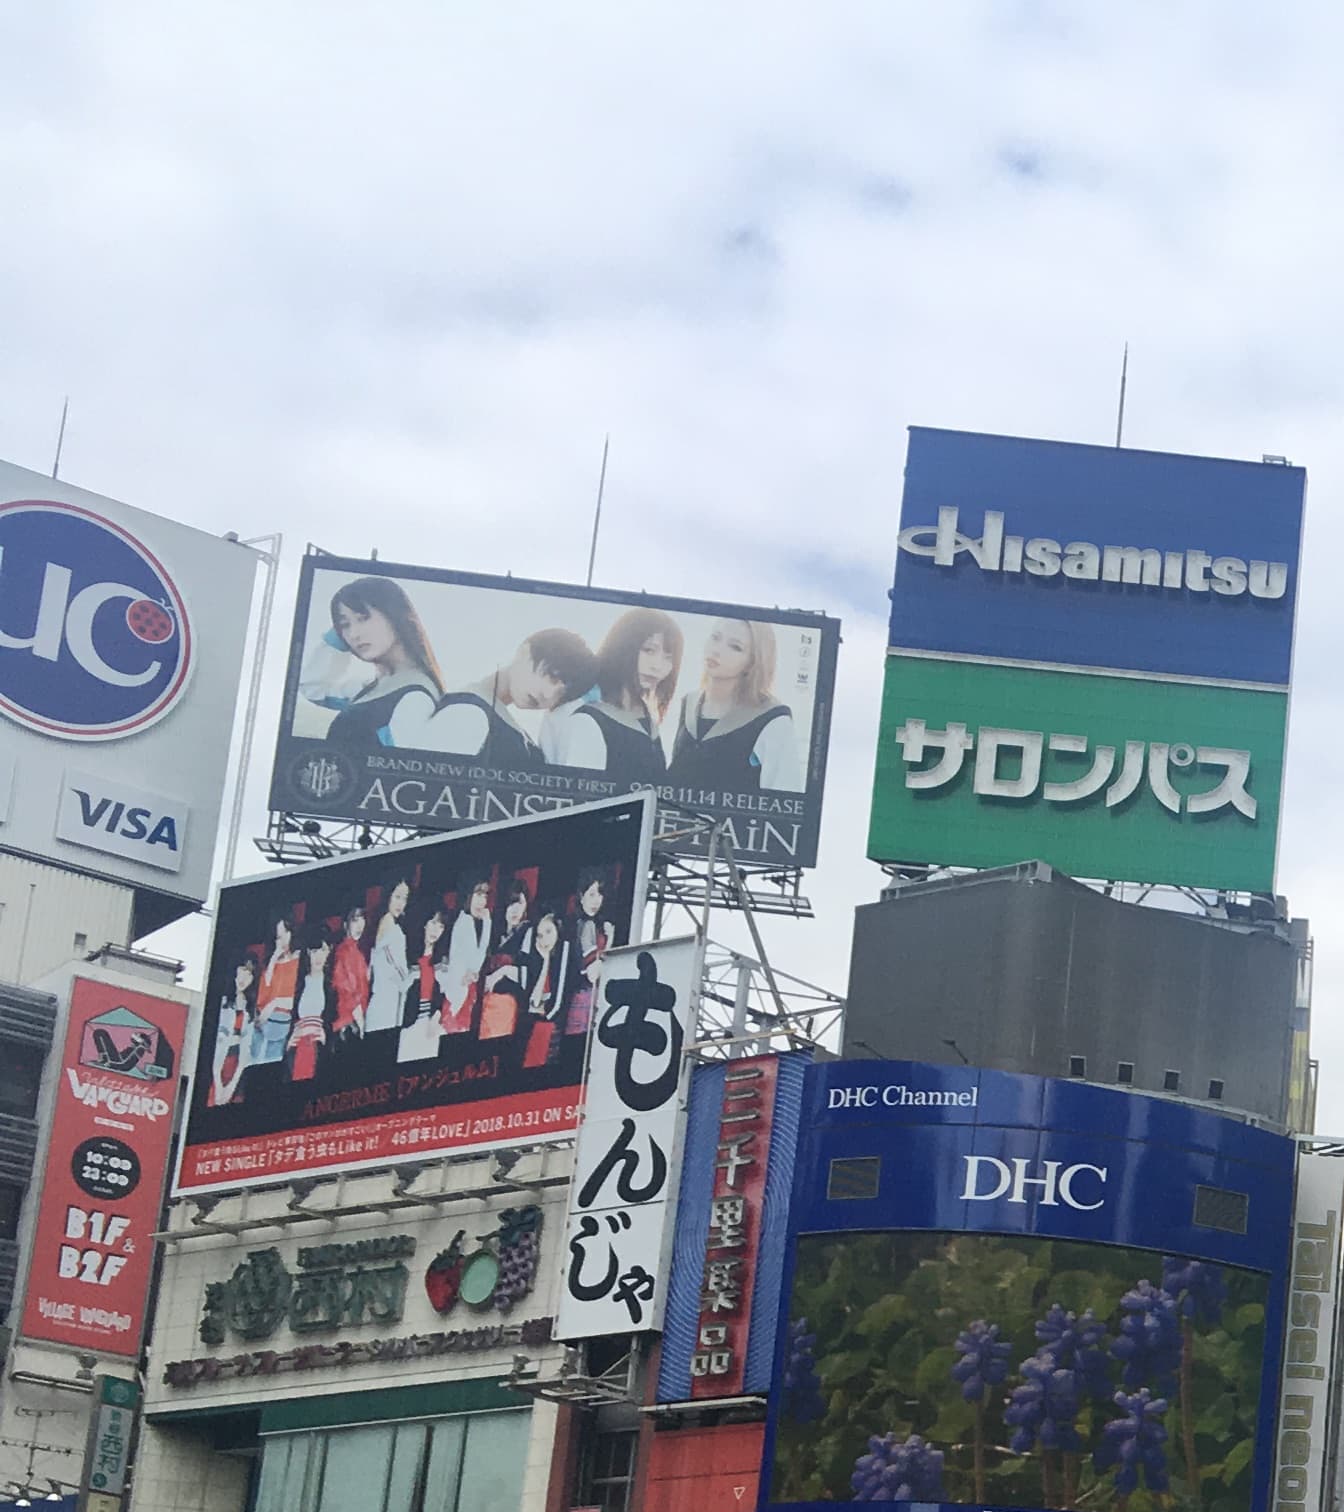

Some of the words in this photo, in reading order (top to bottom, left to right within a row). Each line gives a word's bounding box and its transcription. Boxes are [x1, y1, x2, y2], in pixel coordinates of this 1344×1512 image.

[897, 506, 1289, 599] Hisamitsu
[367, 756, 424, 776] BRAND
[425, 762, 463, 778] NEW
[895, 719, 1257, 820] サロンパス
[71, 788, 178, 852] VISA
[722, 793, 804, 815] RELEASE
[829, 1087, 877, 1109] DHC
[882, 1086, 978, 1107] Channel
[195, 1159, 221, 1176] NEW
[224, 1153, 266, 1172] SINGLE
[543, 1107, 562, 1123] ON
[569, 951, 684, 1325] もんじゃ
[960, 1156, 1107, 1210] DHC
[65, 1206, 131, 1246] B1F
[690, 1066, 763, 1377] 三千里薬品
[59, 1245, 127, 1286] B2F
[1286, 1209, 1336, 1382] Taisei
